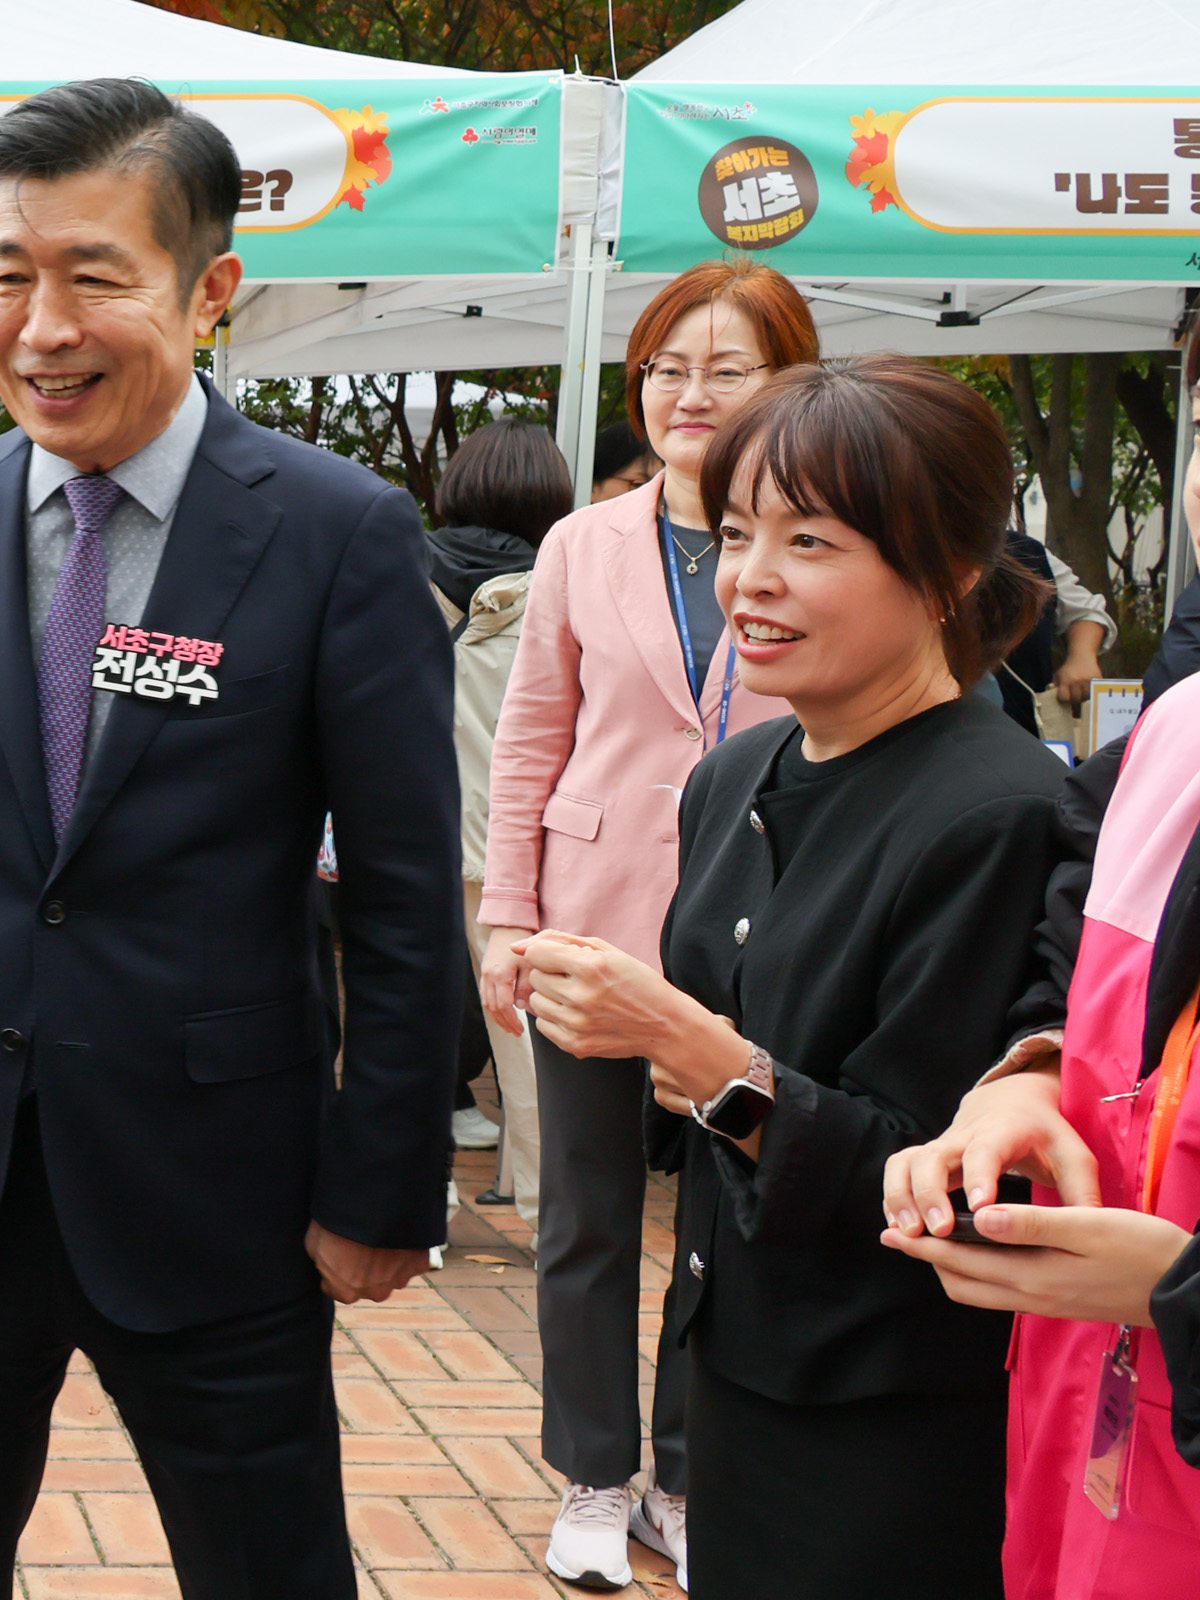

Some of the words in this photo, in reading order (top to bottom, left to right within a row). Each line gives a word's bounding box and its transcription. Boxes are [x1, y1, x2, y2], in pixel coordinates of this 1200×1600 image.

[712, 106, 749, 121] 서초
[715, 146, 791, 181] 찾아가는
[722, 171, 802, 222] 서초
[726, 208, 806, 242] 복지박람회
[99, 623, 225, 667] 서초구청장
[91, 647, 220, 706] 전성수
